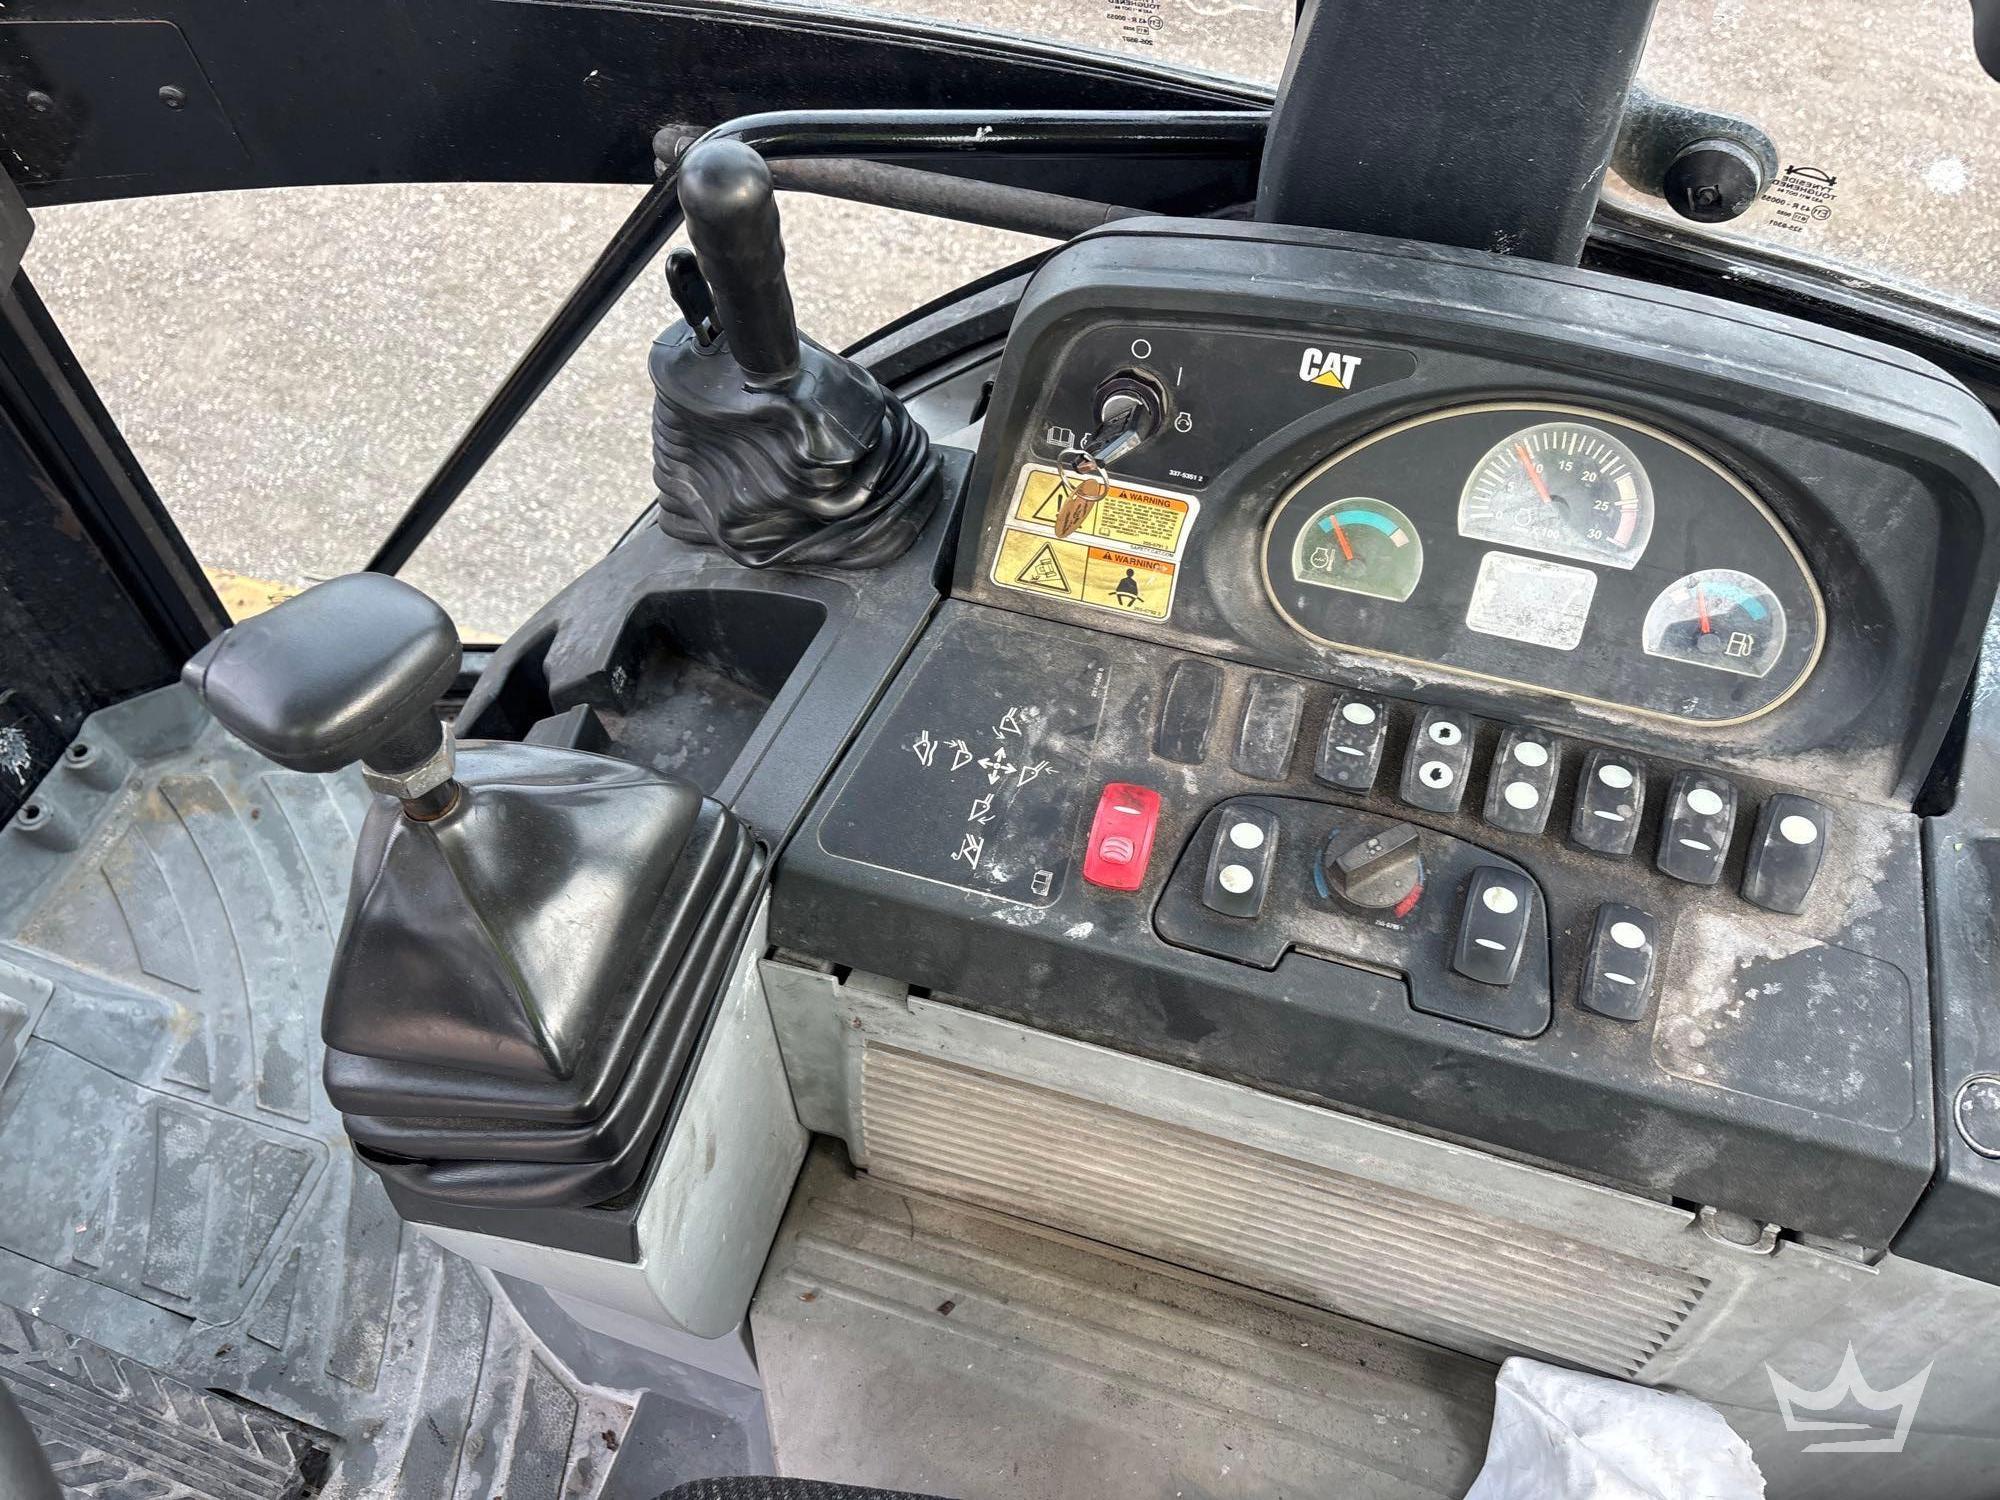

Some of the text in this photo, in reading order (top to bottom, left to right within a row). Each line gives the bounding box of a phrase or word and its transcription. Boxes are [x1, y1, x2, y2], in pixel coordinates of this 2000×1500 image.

[1299, 347, 1362, 390] CAT
[1558, 460, 1574, 471] 15
[1581, 470, 1597, 482] 20
[1507, 481, 1515, 492] 5
[1129, 492, 1171, 508] WARNING
[1593, 499, 1609, 511] 25
[1495, 510, 1503, 519] 0
[1541, 526, 1560, 539] 100
[1586, 528, 1603, 539] 30
